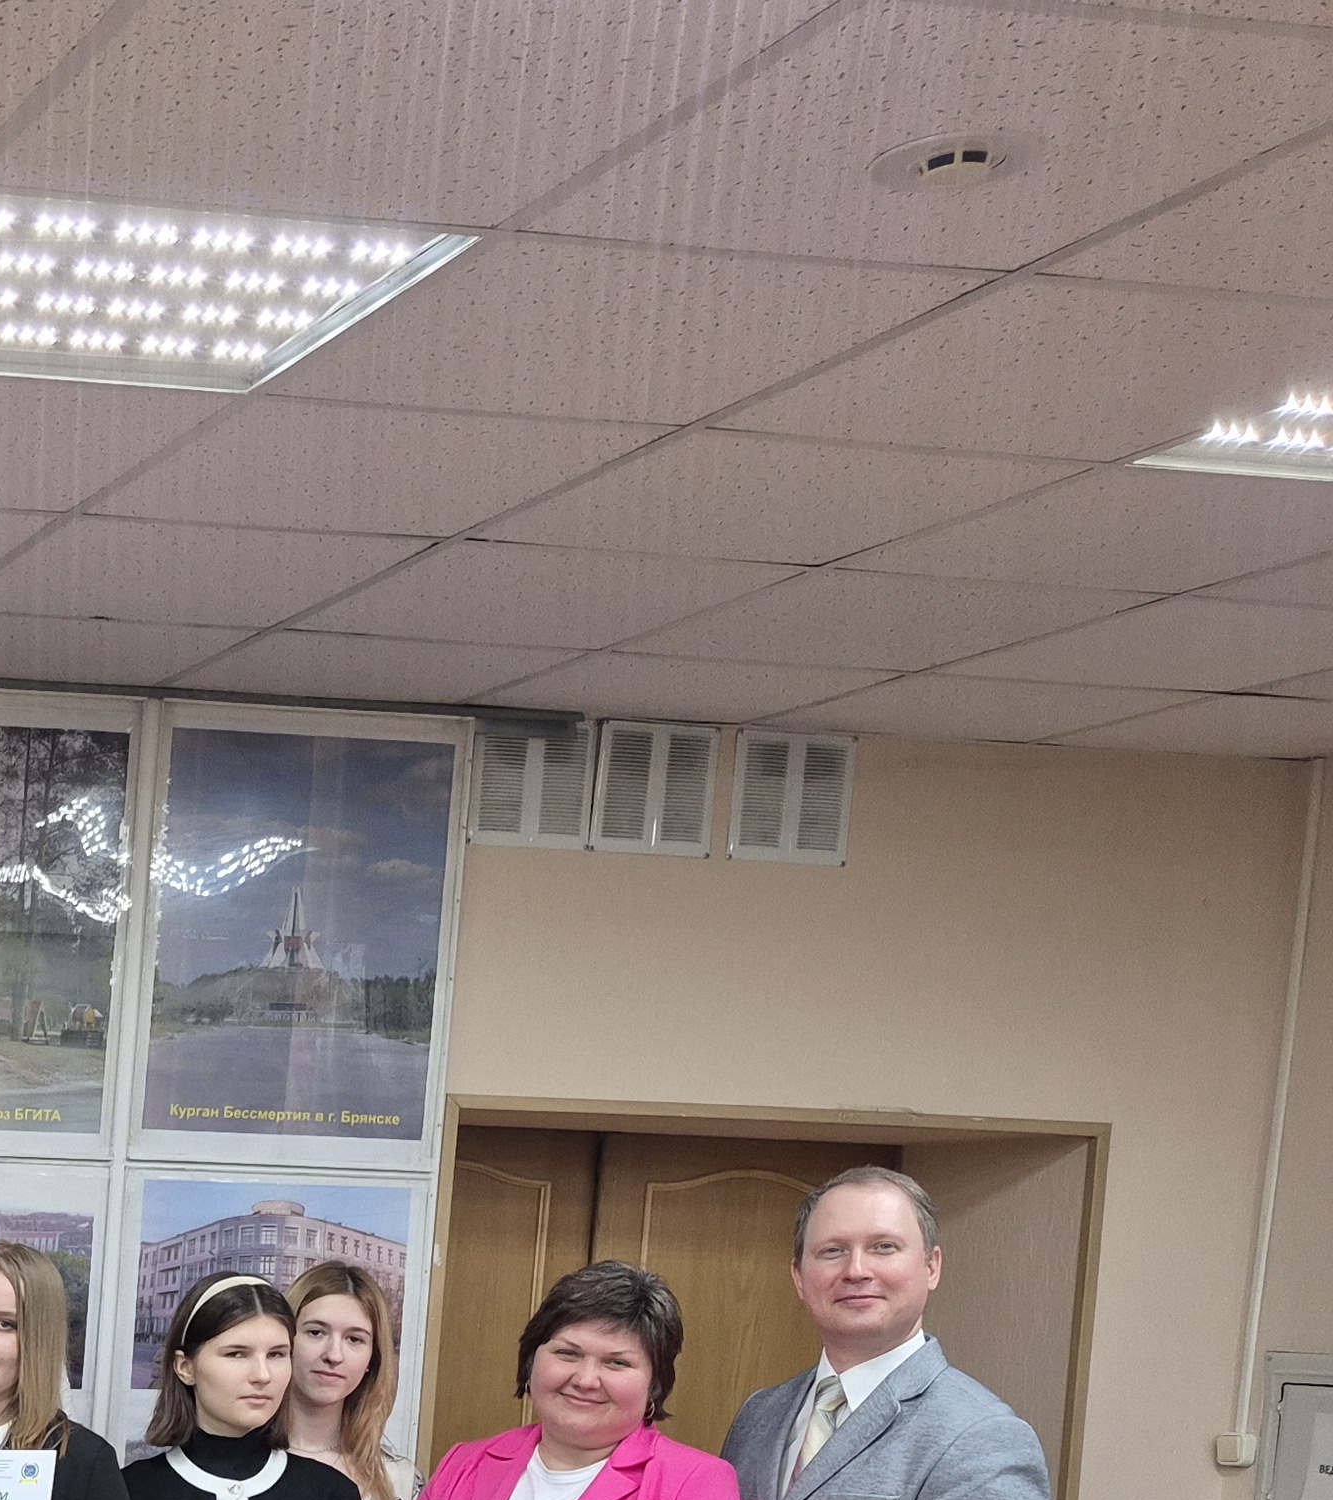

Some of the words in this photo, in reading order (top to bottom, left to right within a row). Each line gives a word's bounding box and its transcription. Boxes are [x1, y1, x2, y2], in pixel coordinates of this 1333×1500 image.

[14, 1108, 61, 1122] БГИТА
[170, 1103, 219, 1119] Курган
[223, 1106, 310, 1123] Бессмертия
[315, 1113, 323, 1122] в
[328, 1113, 336, 1123] г.
[340, 1111, 400, 1126] Брянске
